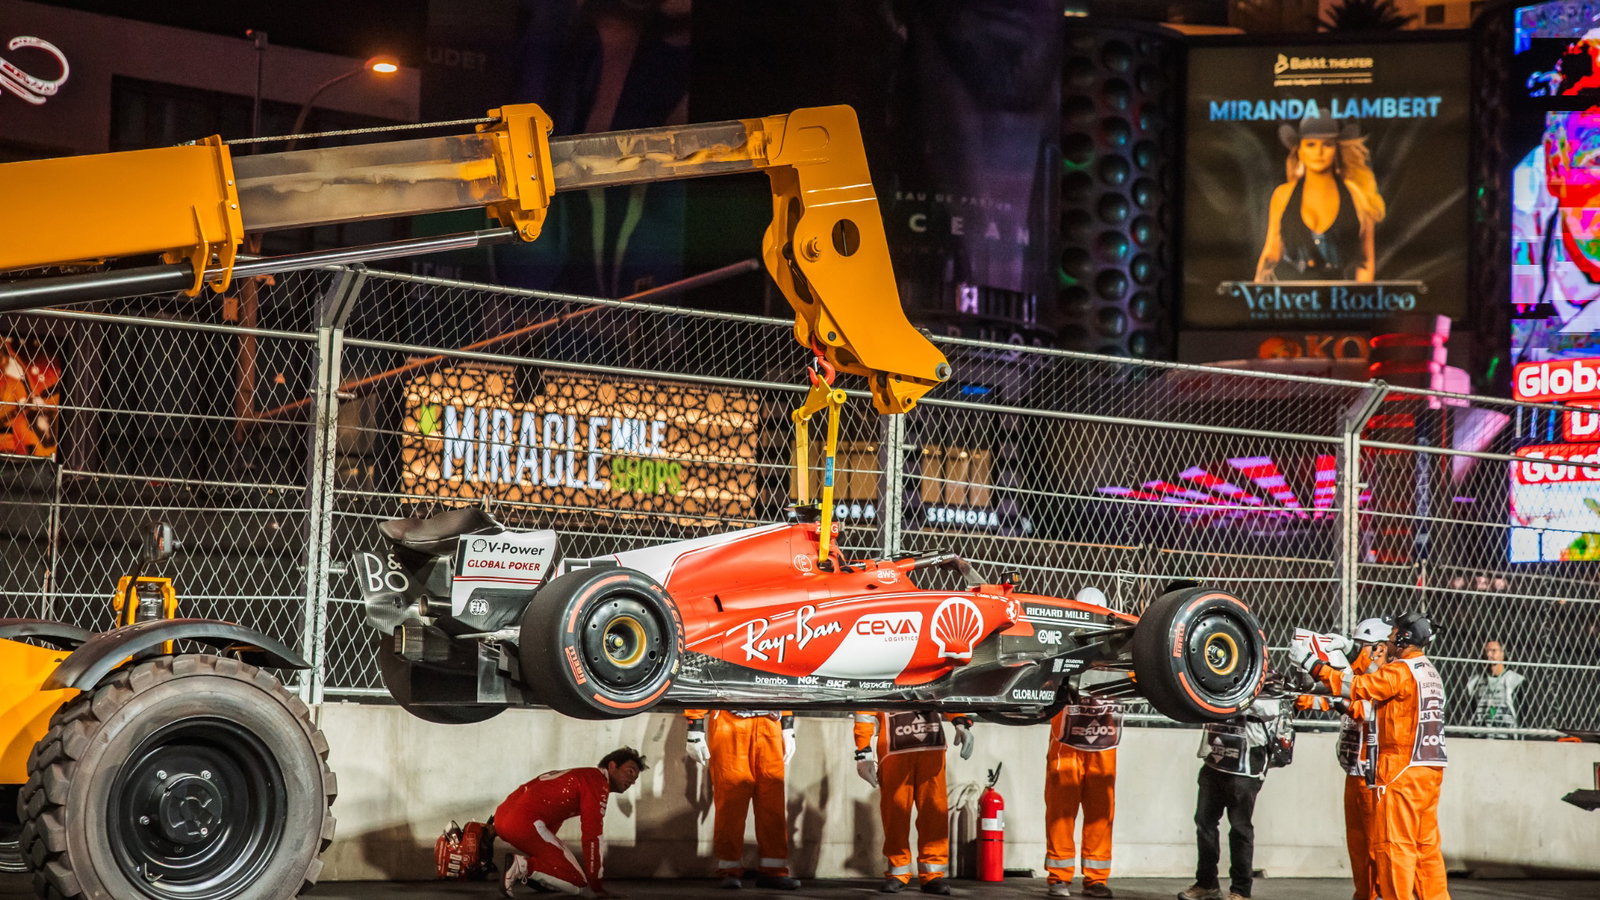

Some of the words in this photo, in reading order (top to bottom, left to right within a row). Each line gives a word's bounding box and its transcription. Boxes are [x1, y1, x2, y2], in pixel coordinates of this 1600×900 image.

[1209, 99, 1320, 121] MIRANDA
[1330, 96, 1442, 119] LAMBERT
[1232, 284, 1322, 311] Velvet
[1330, 285, 1417, 311] Rodeo
[1518, 360, 1600, 397] Glob
[611, 416, 666, 456] MILE
[442, 404, 608, 490] MIRACLE
[610, 457, 682, 495] SHOPS
[927, 507, 999, 527] SEPHORA
[488, 541, 545, 556] V-Power
[467, 559, 506, 570] GLOBAL
[508, 561, 541, 571] POKER
[1026, 607, 1063, 618] RICHARD
[1064, 610, 1090, 620] MILLE
[755, 676, 788, 685] brembo
[797, 676, 819, 685] NGK
[1012, 689, 1038, 700] GLOBAL
[1038, 690, 1056, 700] POKER
